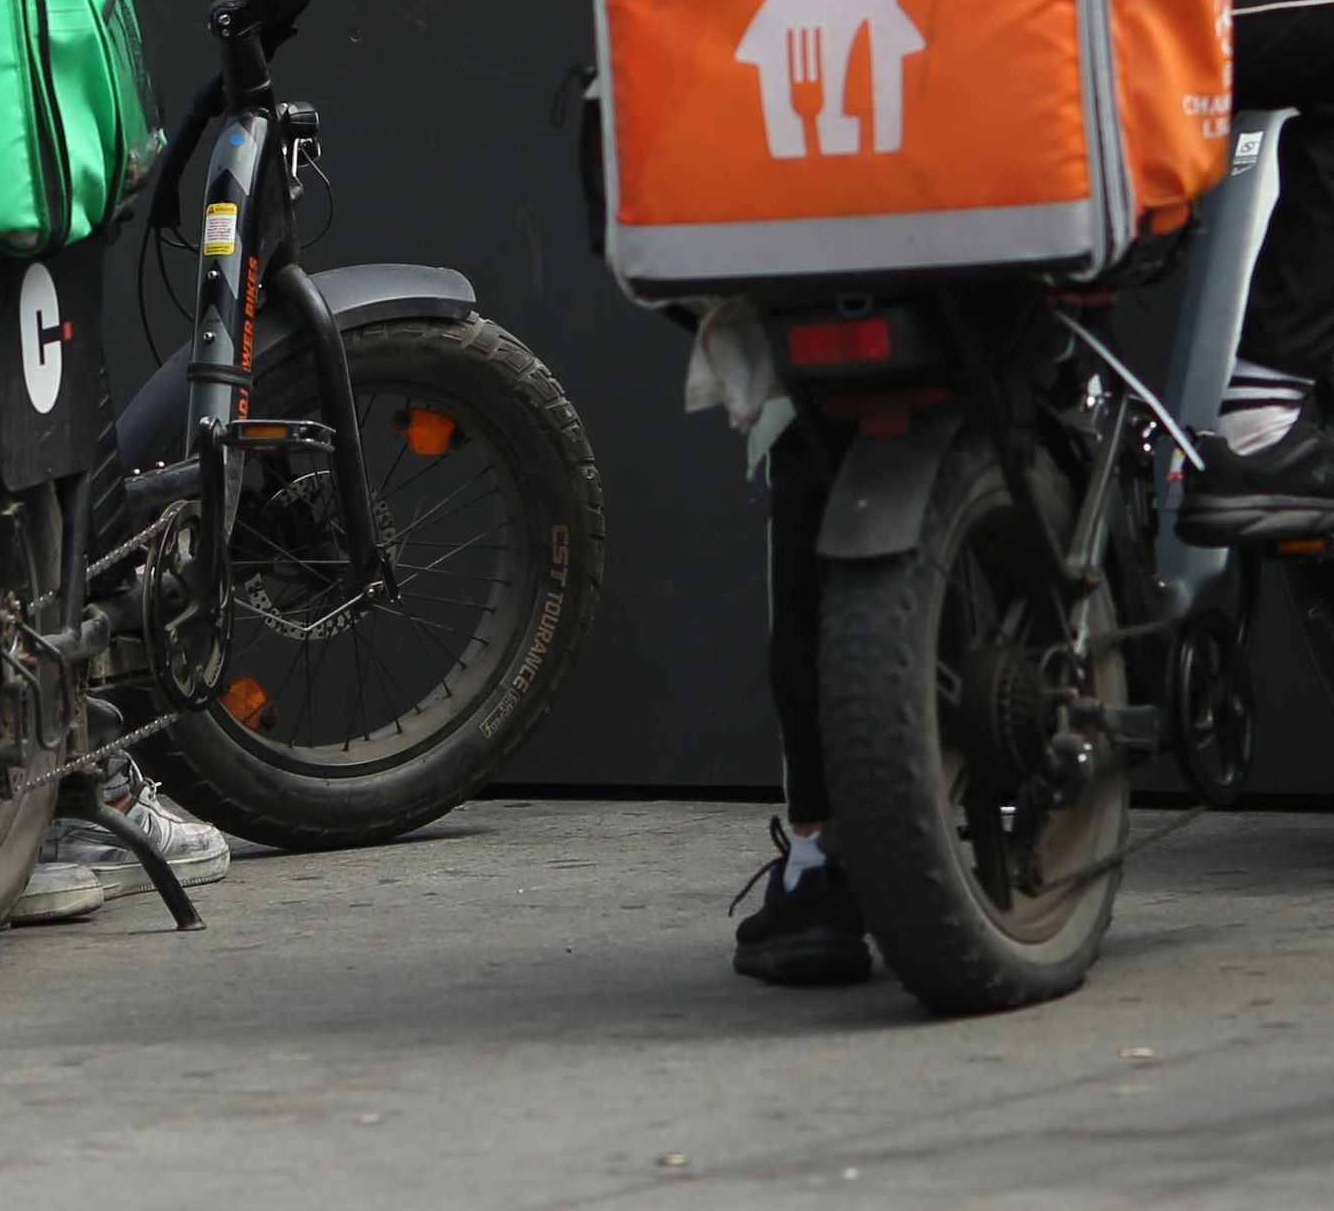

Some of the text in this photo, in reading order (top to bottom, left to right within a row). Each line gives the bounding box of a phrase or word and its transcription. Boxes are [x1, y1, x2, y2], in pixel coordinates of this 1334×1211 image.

[244, 256, 260, 319] BIKES
[512, 524, 570, 694] CST TOURANCE
